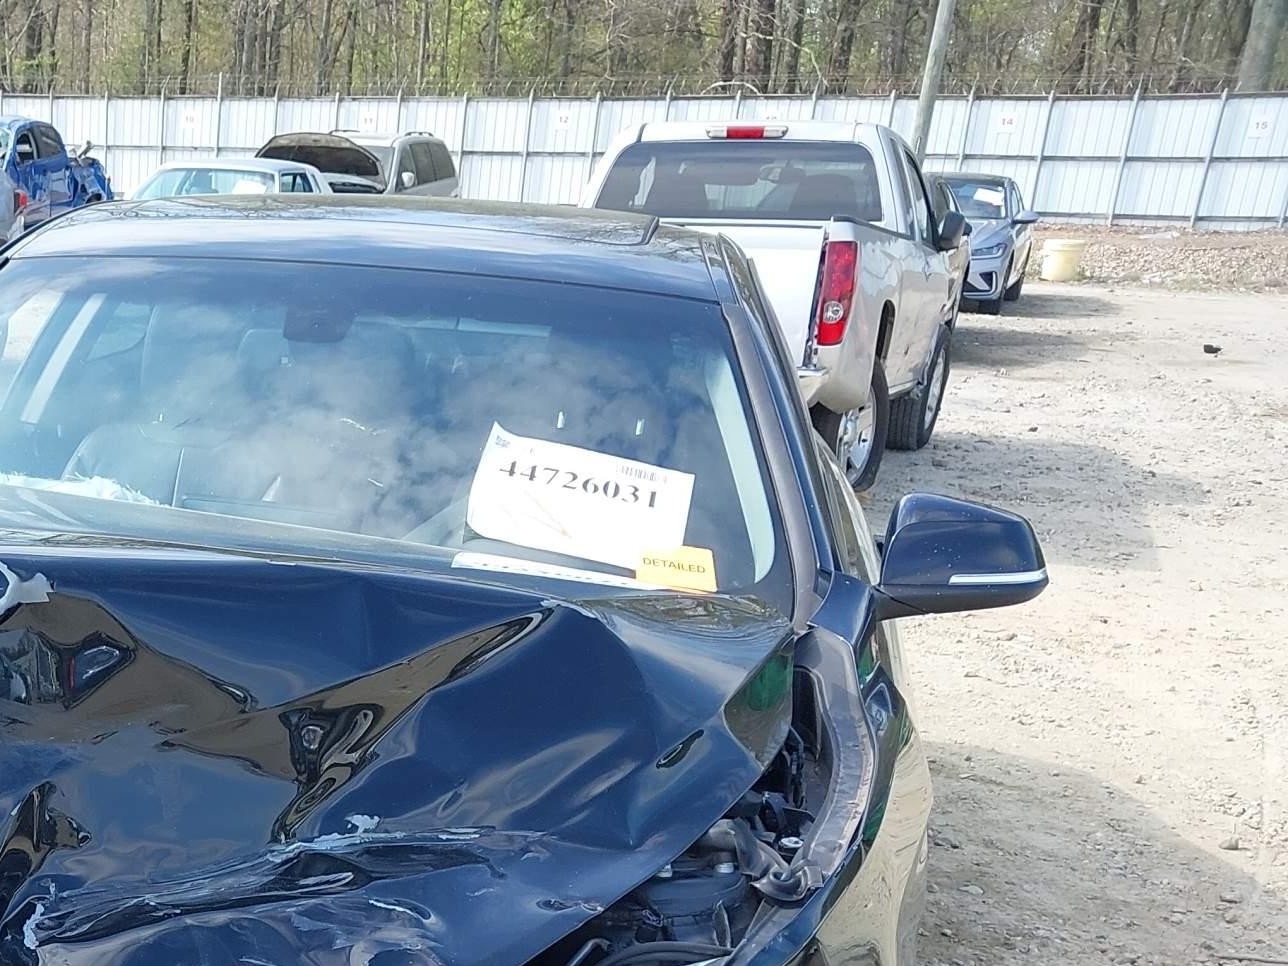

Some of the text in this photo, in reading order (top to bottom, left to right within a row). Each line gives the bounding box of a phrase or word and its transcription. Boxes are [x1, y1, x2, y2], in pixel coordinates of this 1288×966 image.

[1001, 117, 1014, 126] 14
[1255, 121, 1269, 130] 15
[499, 459, 658, 509] 44726031
[642, 557, 707, 574] DETAILED
